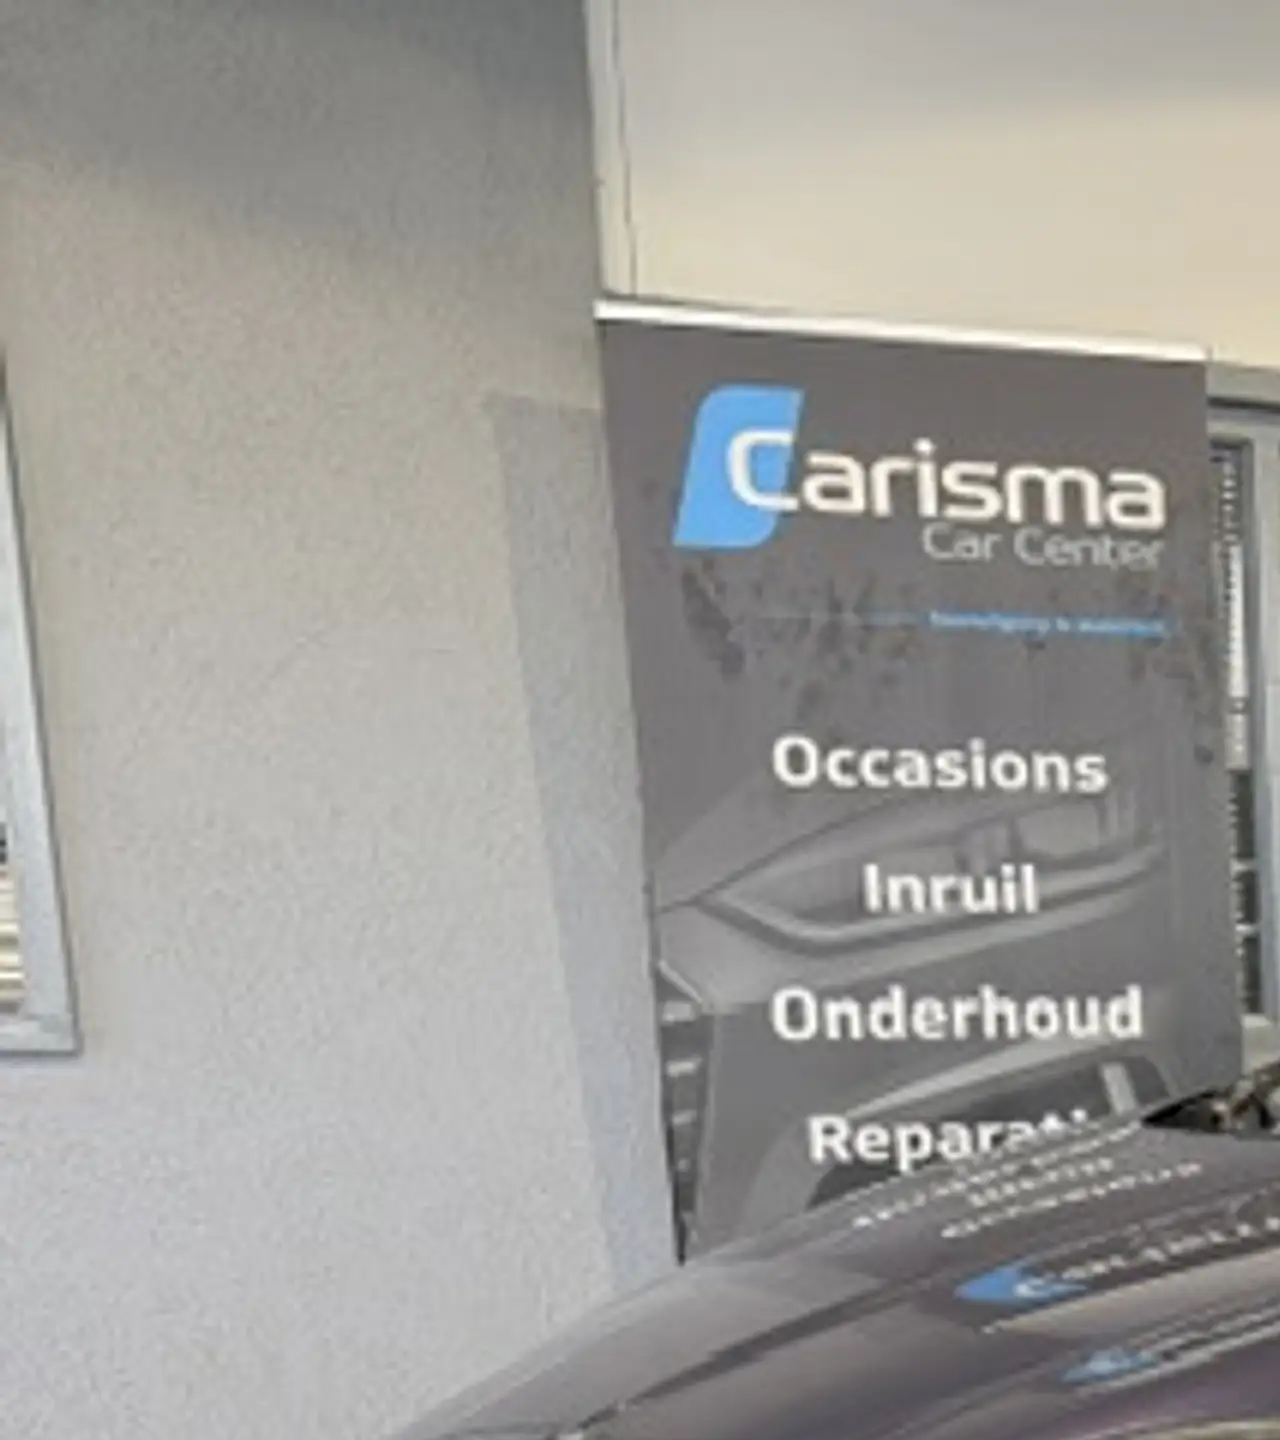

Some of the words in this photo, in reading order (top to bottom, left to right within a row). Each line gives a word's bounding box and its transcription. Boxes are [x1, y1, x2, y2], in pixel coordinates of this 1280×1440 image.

[725, 427, 1167, 530] Carisma
[921, 521, 1003, 563] Car
[1013, 528, 1165, 572] Center
[772, 735, 1109, 794] Occasions
[863, 863, 1039, 914] Inruil
[772, 984, 1143, 1041] Onderhoud
